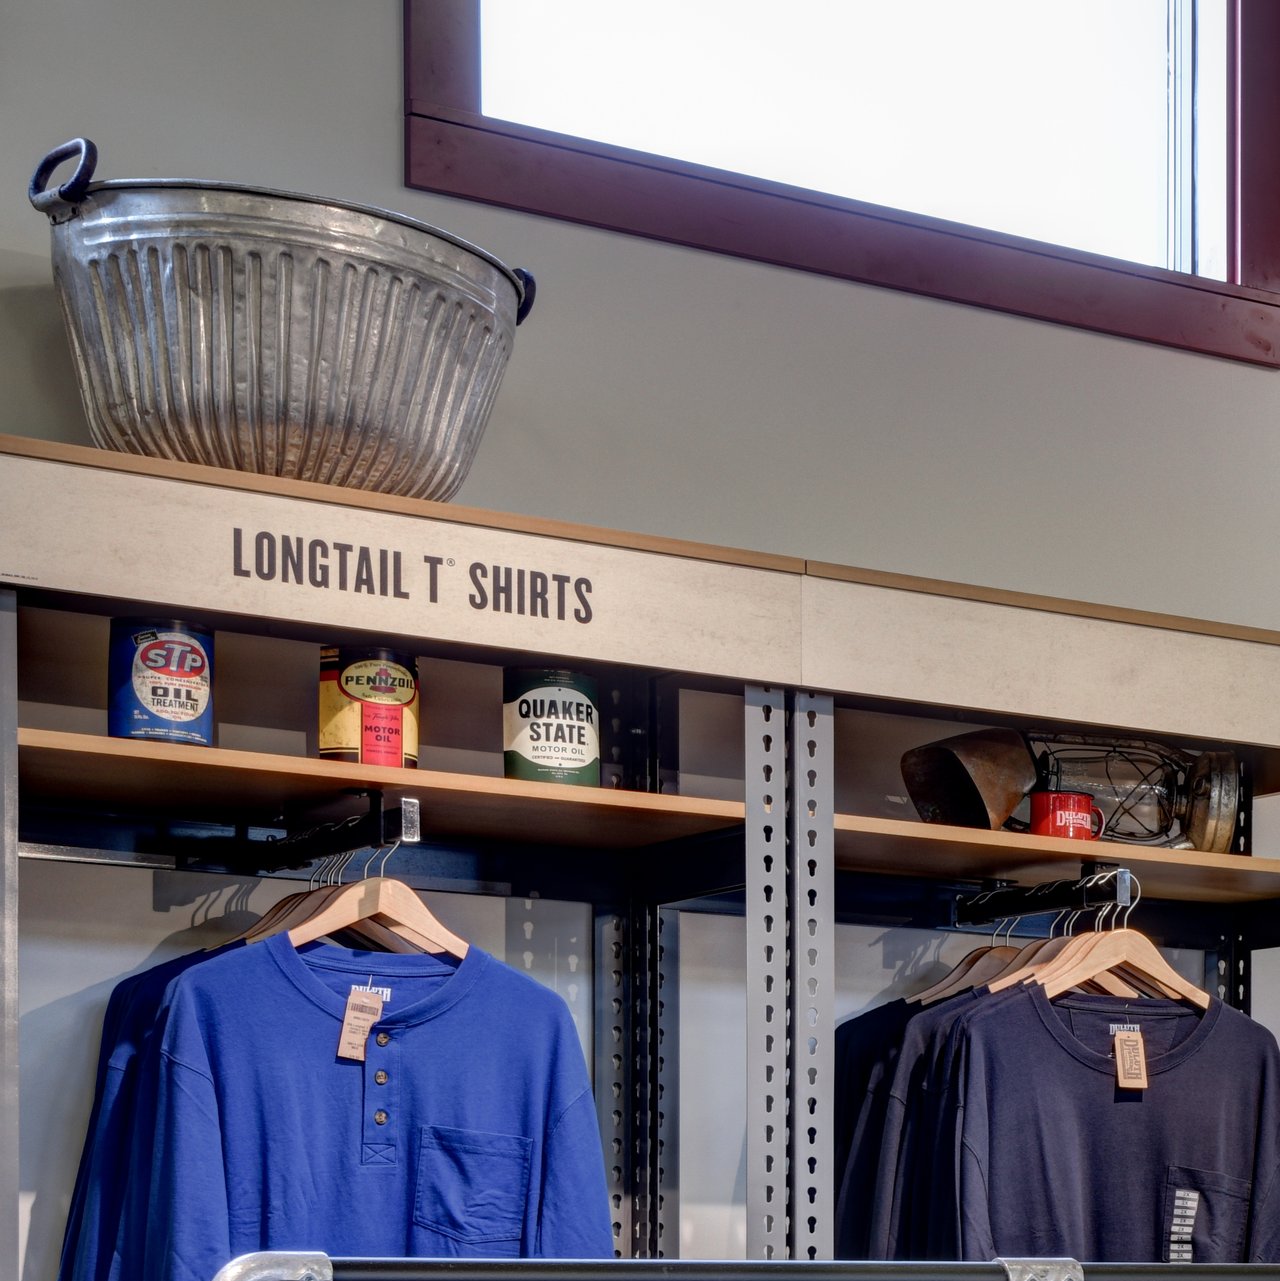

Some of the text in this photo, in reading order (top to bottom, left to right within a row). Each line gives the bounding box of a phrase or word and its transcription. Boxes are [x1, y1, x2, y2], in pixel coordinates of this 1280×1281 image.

[233, 528, 410, 600] LONGTAIL
[468, 562, 593, 624] SHIRTS
[145, 643, 203, 672] STP
[345, 675, 416, 690] PENNZOIL
[151, 686, 199, 702] OIL
[151, 697, 199, 712] TREATMENT
[518, 698, 594, 725] QUAKER
[364, 725, 401, 736] MOTOR
[375, 734, 392, 743] OIL
[532, 745, 585, 756] MOTOR OIL
